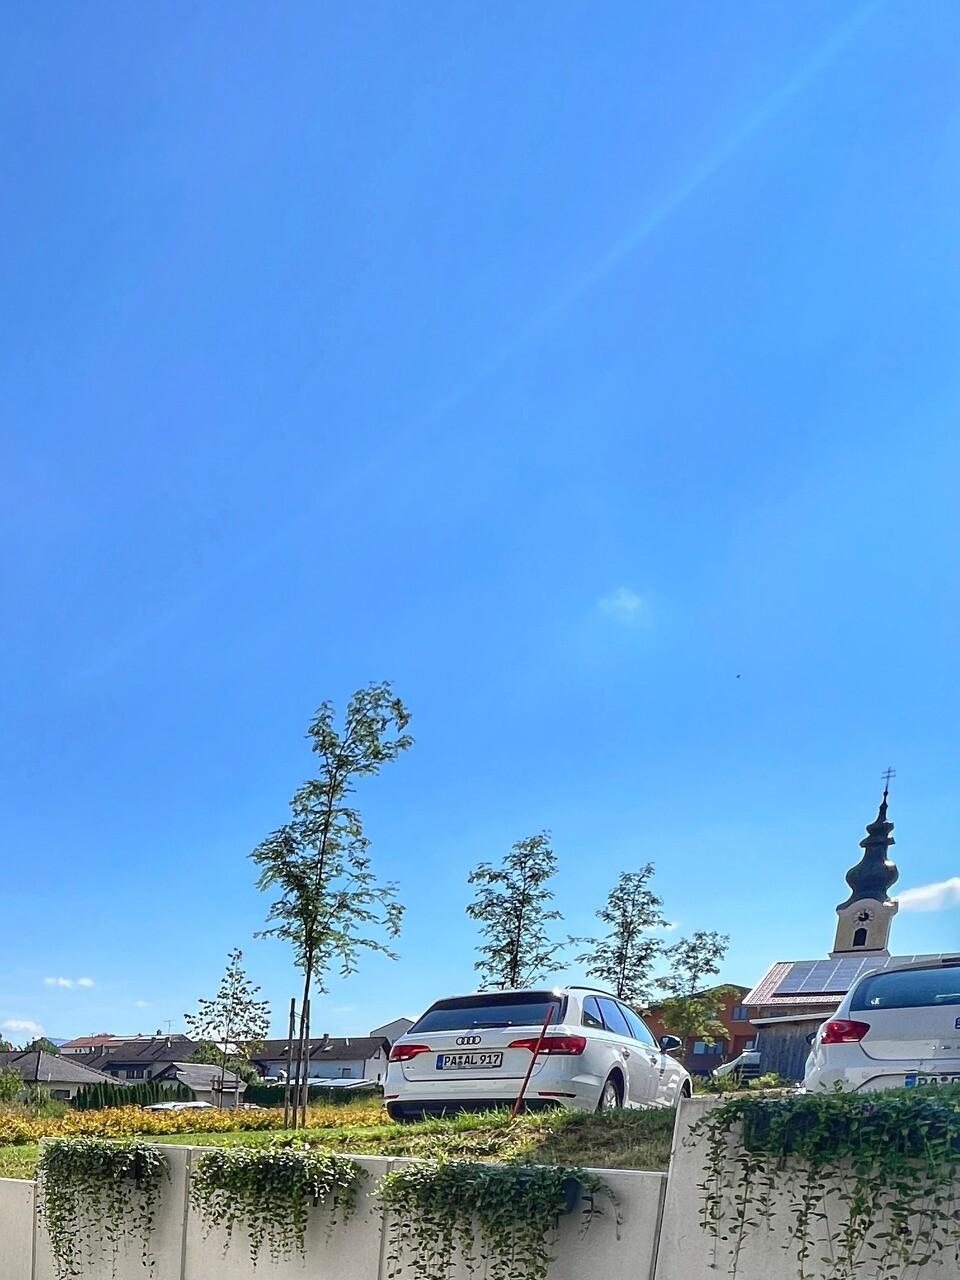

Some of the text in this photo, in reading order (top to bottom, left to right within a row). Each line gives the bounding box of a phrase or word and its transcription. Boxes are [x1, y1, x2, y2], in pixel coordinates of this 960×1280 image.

[444, 1054, 500, 1066] PA AL 917
